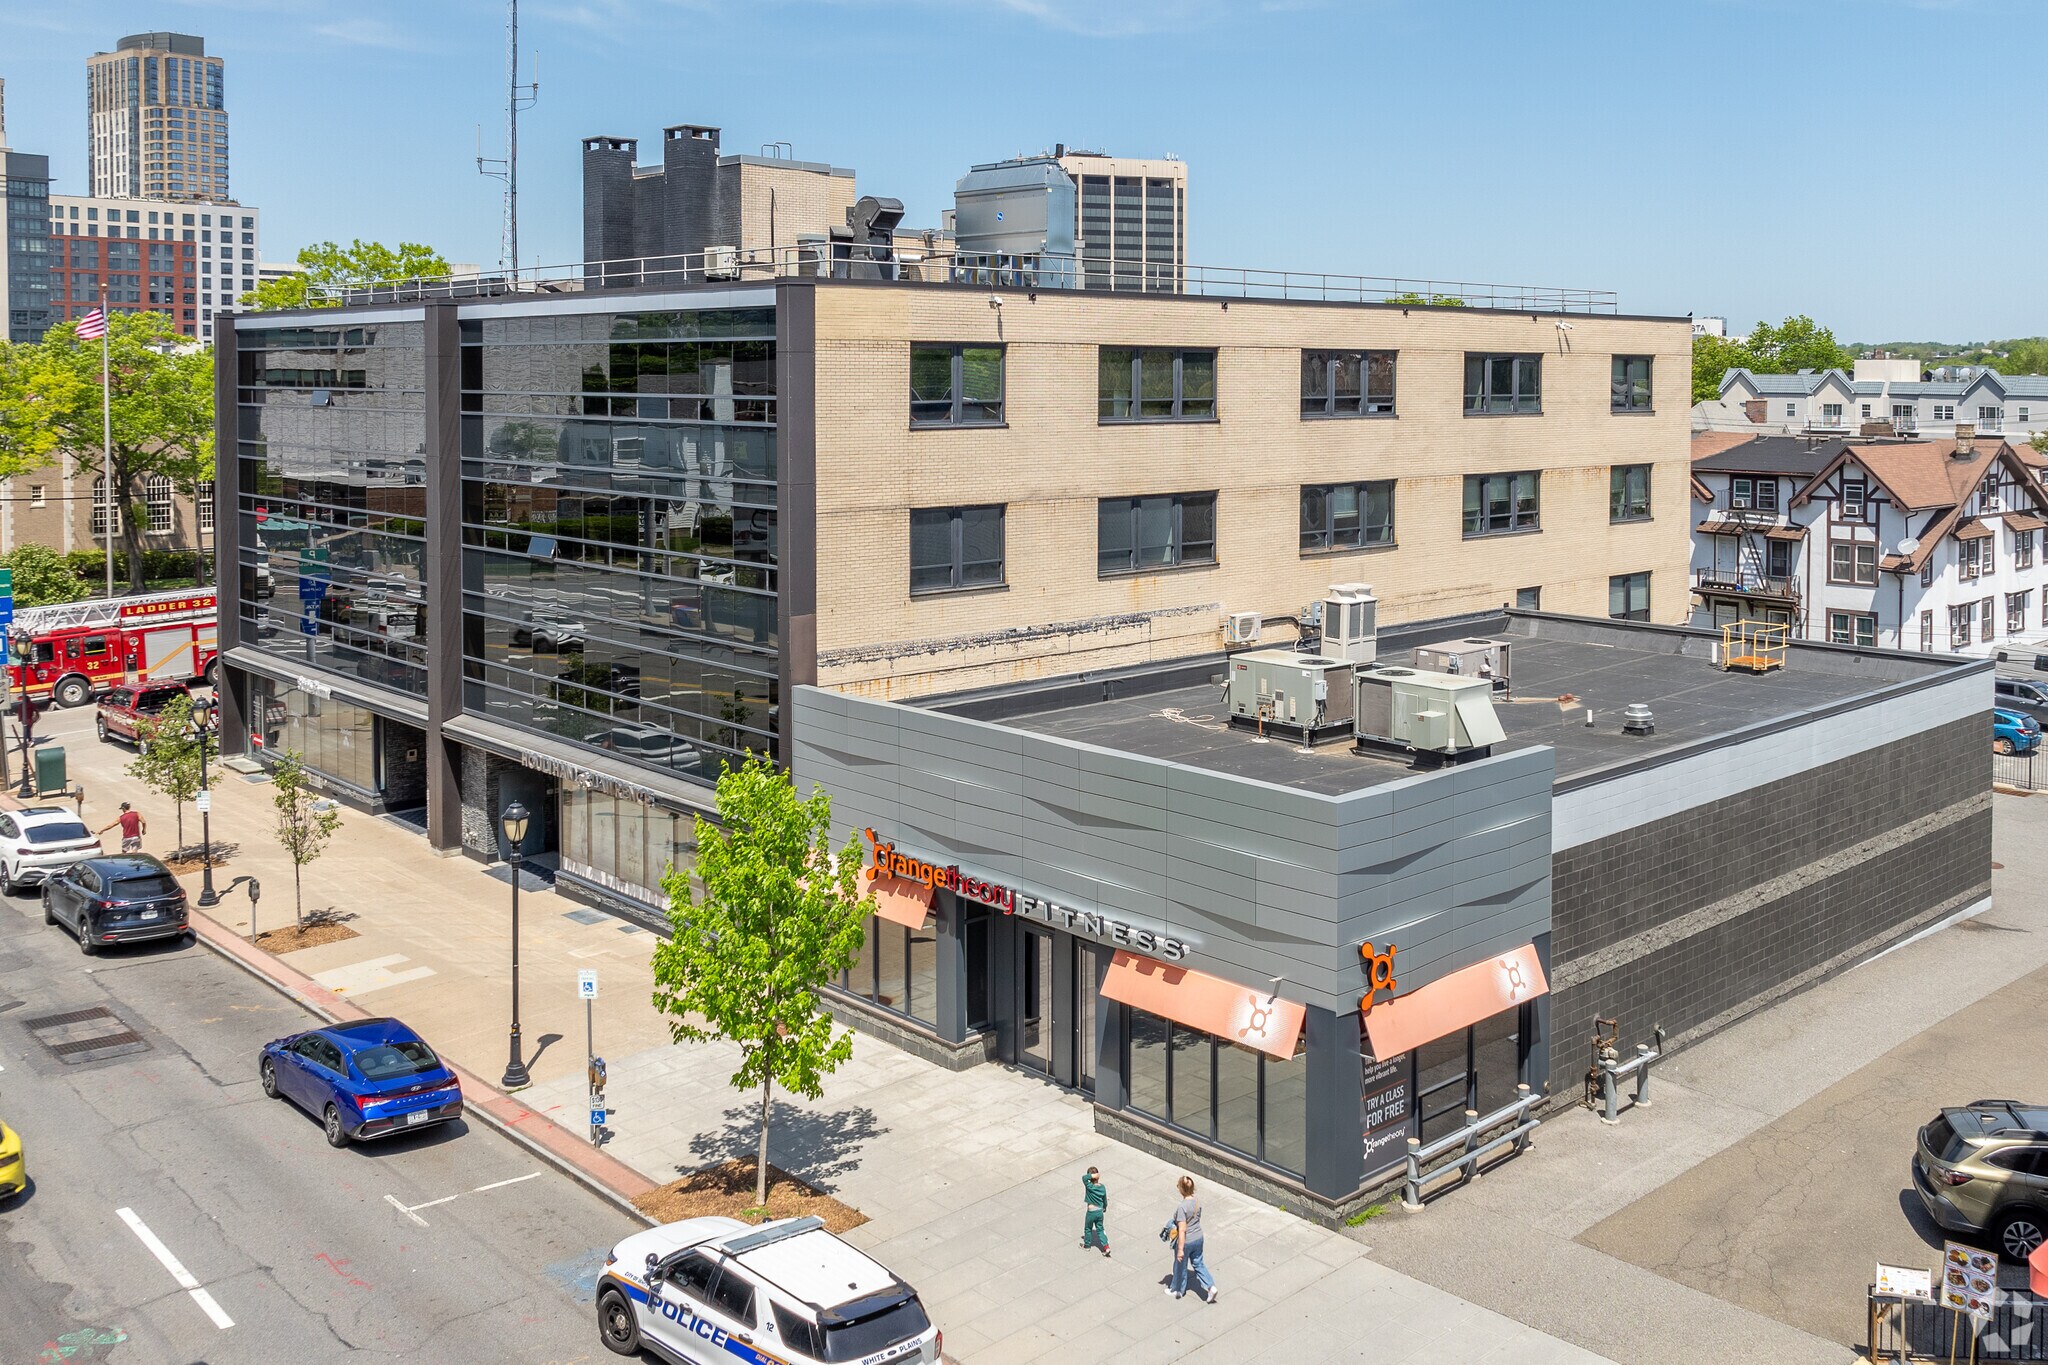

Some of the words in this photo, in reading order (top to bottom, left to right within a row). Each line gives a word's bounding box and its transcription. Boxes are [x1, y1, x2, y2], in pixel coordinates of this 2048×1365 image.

[126, 601, 187, 615] LADDER
[192, 598, 211, 607] 32
[87, 661, 99, 670] 32
[1021, 895, 1185, 961] FITNESS
[1364, 1076, 1376, 1085] more
[1375, 1069, 1390, 1080] vibrant
[1366, 1096, 1379, 1111] TRY
[1380, 1093, 1385, 1106] A
[1385, 1085, 1404, 1103] CLASS
[1366, 1109, 1383, 1129] FOR
[1384, 1099, 1405, 1121] FREE
[648, 1293, 728, 1349] POLICE
[765, 1321, 775, 1332] 12
[755, 1353, 768, 1364] DIAL
[861, 1353, 886, 1365] WHITE
[898, 1338, 923, 1353] PLAINS
